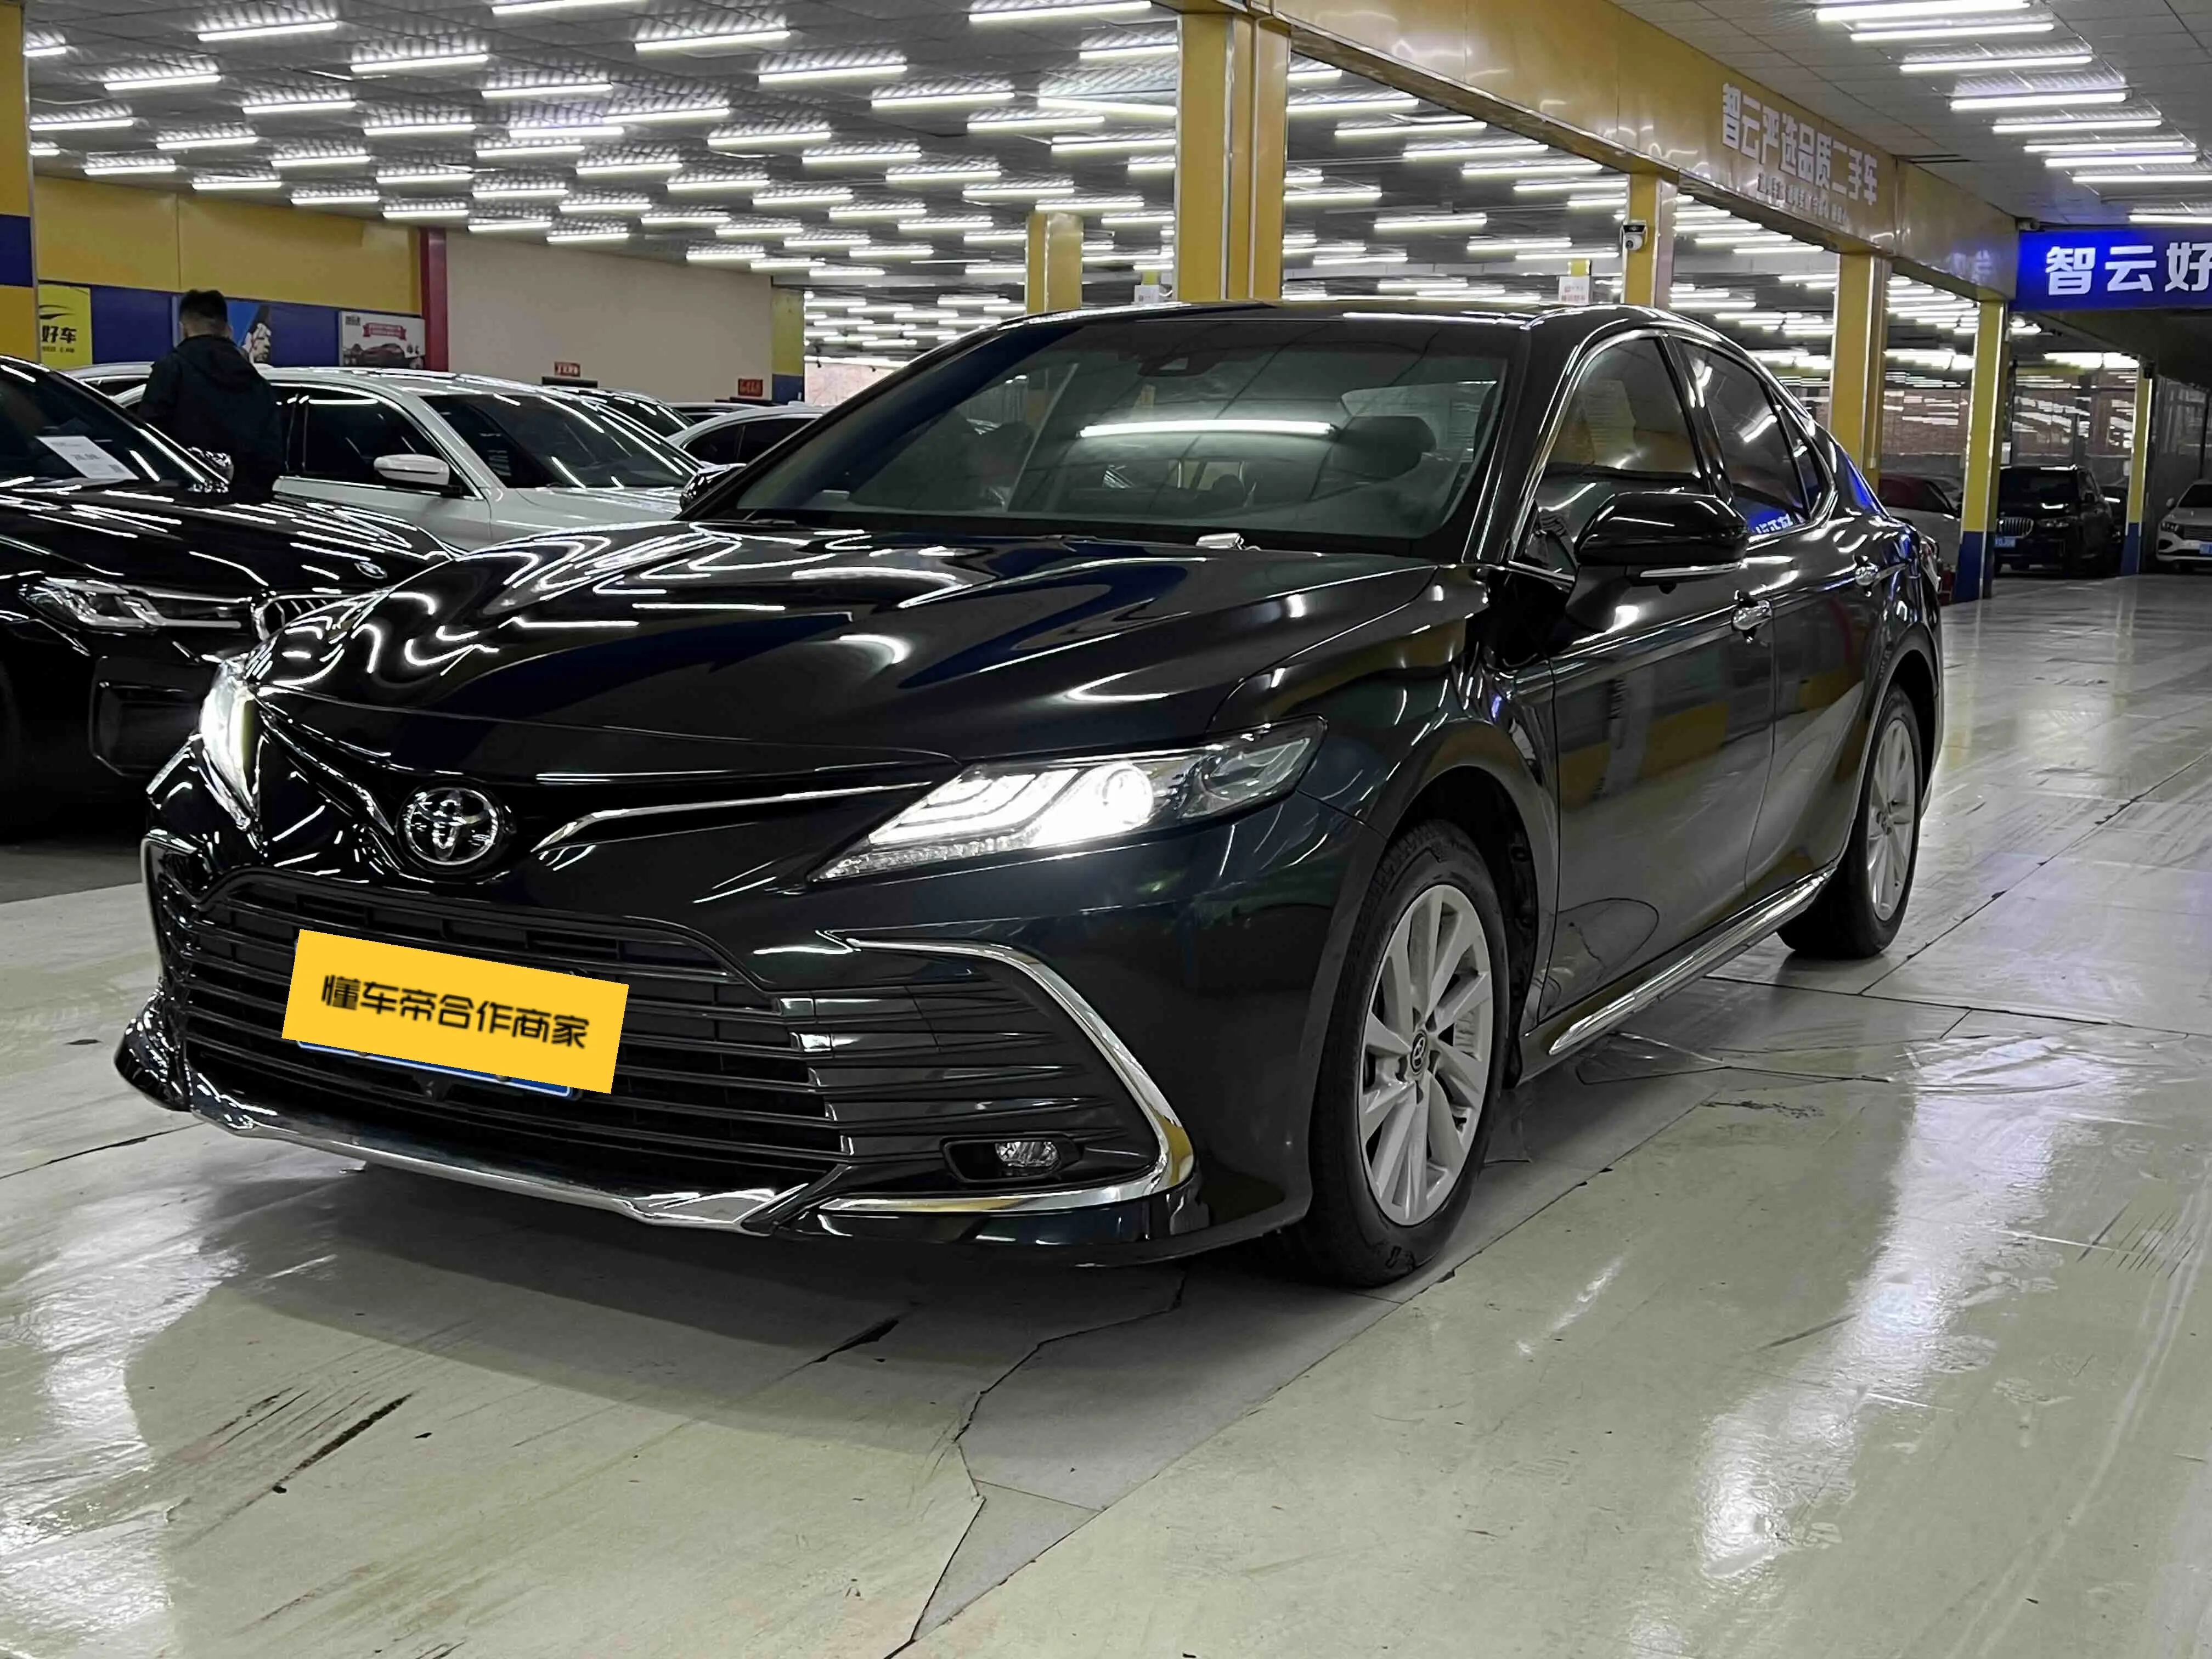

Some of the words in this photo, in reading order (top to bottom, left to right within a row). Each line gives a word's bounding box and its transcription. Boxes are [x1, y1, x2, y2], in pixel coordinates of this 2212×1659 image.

[1722, 82, 1878, 207] 智云严选品质二手车
[2045, 241, 2212, 296] 智云好
[42, 325, 77, 343] 好车
